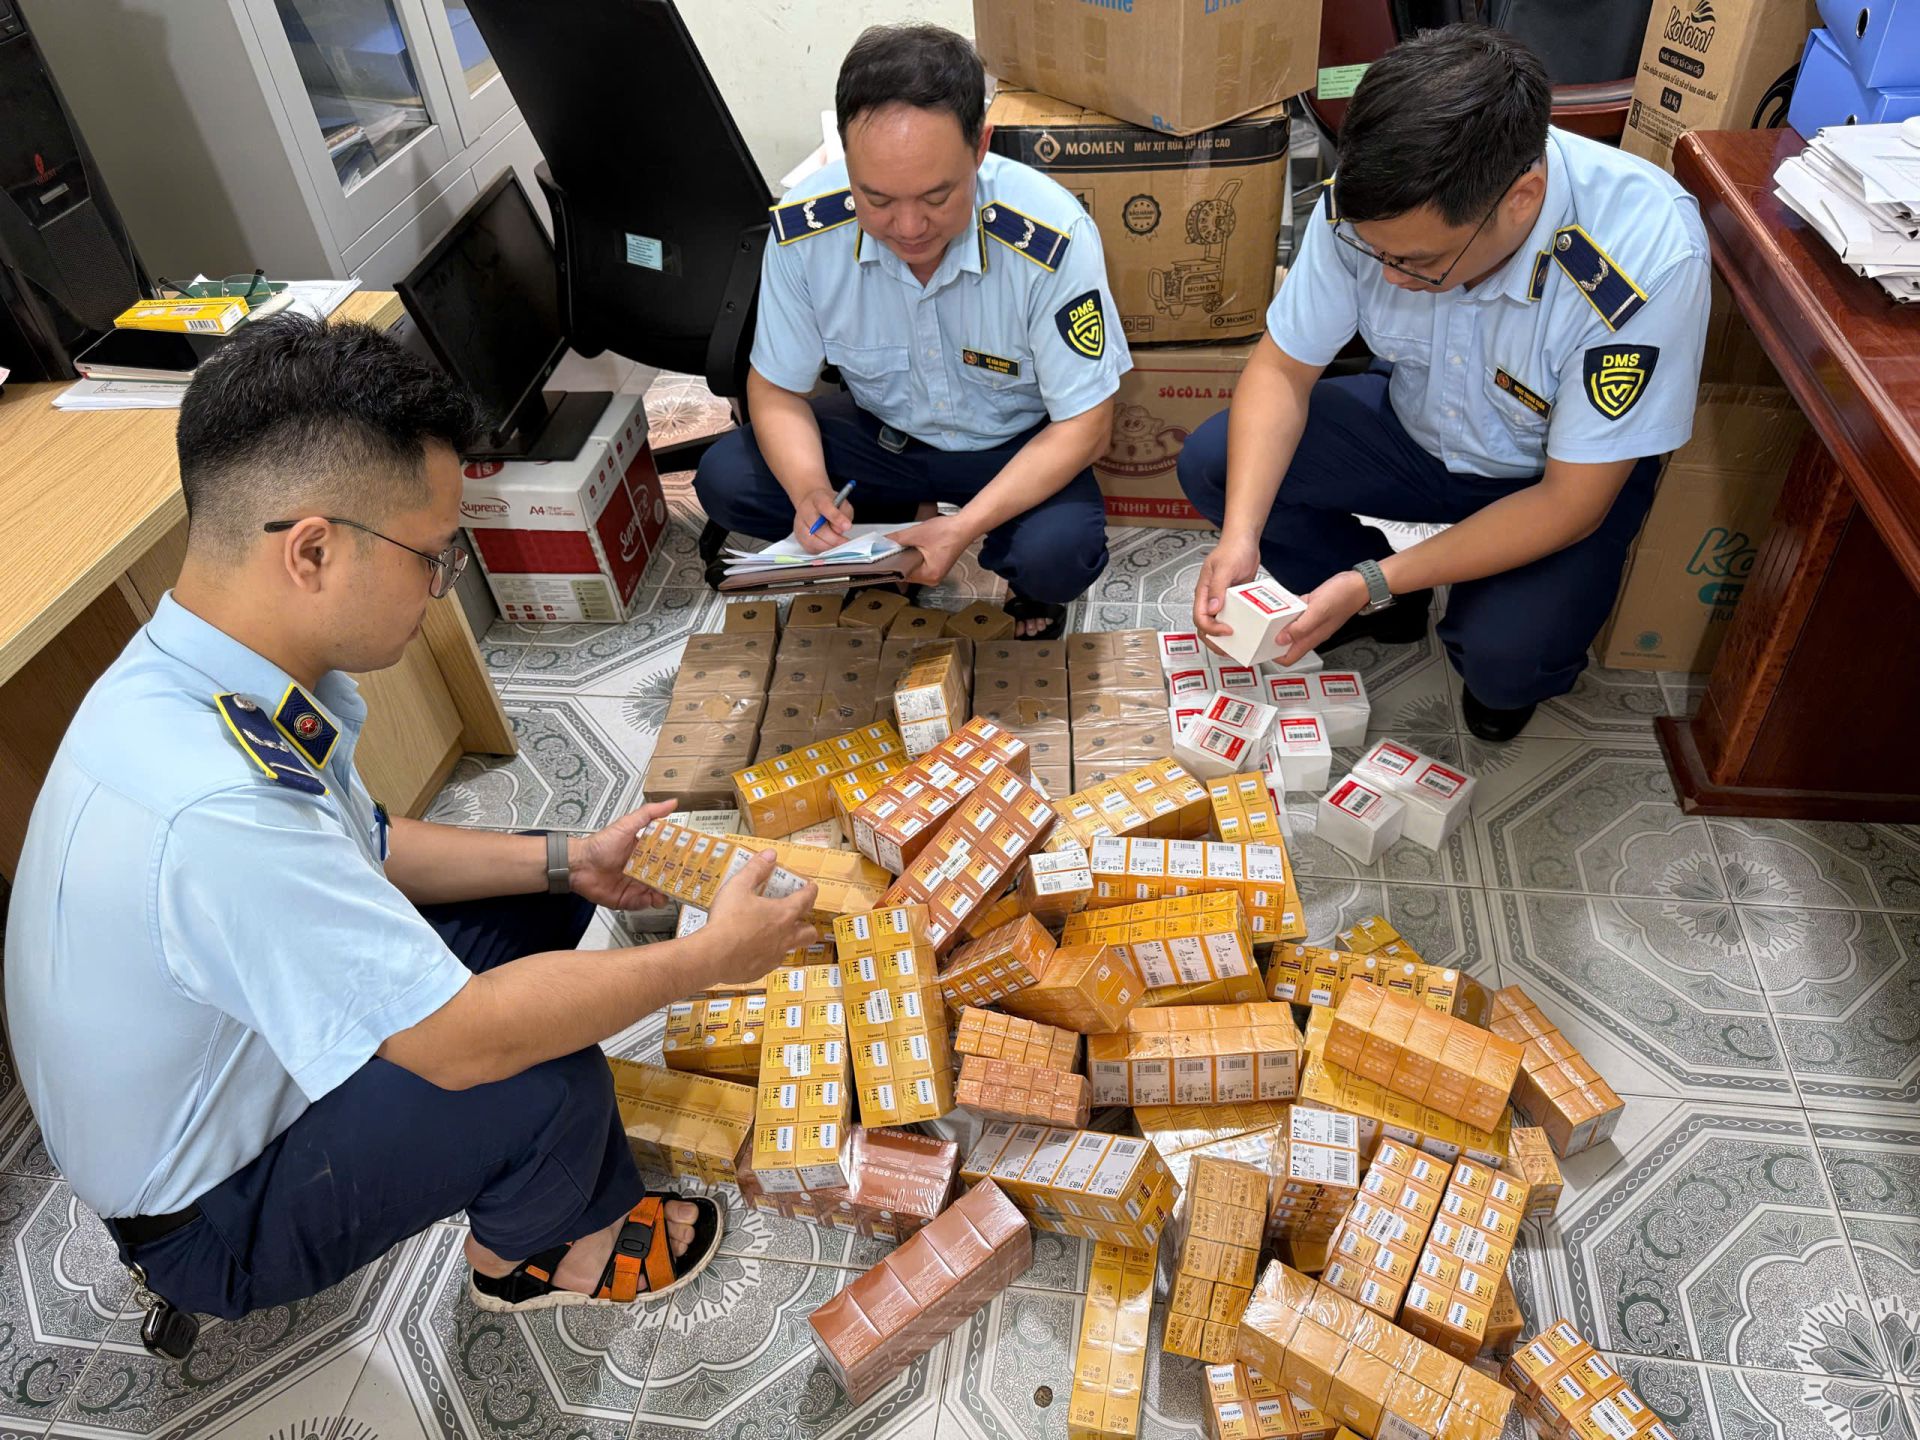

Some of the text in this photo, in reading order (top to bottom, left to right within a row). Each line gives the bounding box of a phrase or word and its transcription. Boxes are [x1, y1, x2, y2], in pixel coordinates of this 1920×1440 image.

[1663, 5, 1715, 54] Kotomi
[1065, 141, 1124, 155] MOMEN
[1215, 138, 1230, 148] CAO
[1187, 284, 1216, 293] MOMEN
[1069, 298, 1095, 322] DMS
[1226, 314, 1253, 323] MOMEN
[1602, 353, 1641, 367] DMS
[462, 501, 507, 514] Supreme
[530, 506, 545, 515] A4
[1110, 502, 1190, 515] TNHH VIỆT
[974, 804, 985, 815] H4
[1029, 800, 1040, 810] H4
[1003, 829, 1013, 840] H4
[738, 848, 750, 860] H4
[924, 863, 933, 875] H4
[977, 860, 987, 871] H4
[775, 869, 786, 879] H4
[950, 890, 961, 901] H4
[885, 913, 892, 925] H4
[847, 920, 853, 932] H4
[890, 955, 897, 966] H4
[852, 961, 859, 972] H4
[782, 973, 788, 983] H4
[822, 969, 828, 979] H4
[1287, 976, 1296, 984] H4
[897, 997, 904, 1008] H4
[1436, 1004, 1446, 1012] H4
[780, 1009, 786, 1019] H4
[820, 1006, 826, 1016] H4
[859, 1003, 865, 1015] H4
[818, 1044, 824, 1055] H4
[864, 1045, 871, 1057] H4
[903, 1040, 910, 1051] H4
[776, 1047, 783, 1058] H4
[773, 1087, 779, 1098] H4
[816, 1085, 822, 1096] H4
[872, 1088, 878, 1100] H4
[910, 1083, 916, 1095] H4
[770, 1129, 776, 1141] H4
[813, 1127, 819, 1138] H4
[1293, 1127, 1301, 1138] H7
[1006, 1171, 1020, 1179] HB3
[1292, 1164, 1300, 1176] H7
[1036, 1176, 1050, 1184] HB3
[1427, 1173, 1433, 1183] H7
[1470, 1175, 1481, 1188] H7
[1069, 1181, 1084, 1189] HB3
[1380, 1185, 1388, 1196] H7
[1103, 1187, 1118, 1196] HB3
[1506, 1191, 1514, 1203] H7
[1415, 1203, 1423, 1212] H7
[1459, 1205, 1468, 1217] H7
[1497, 1221, 1505, 1233] H7
[1403, 1232, 1410, 1243] H7
[1449, 1237, 1457, 1248] H7
[1354, 1246, 1362, 1256] H7
[1487, 1252, 1496, 1264] H7
[1390, 1264, 1399, 1274] H7
[1437, 1268, 1446, 1280] H7
[1340, 1279, 1349, 1289] H7
[1465, 1272, 1475, 1290] PHILIPS
[1476, 1285, 1485, 1297] H7
[1376, 1296, 1385, 1307] H7
[1426, 1300, 1435, 1312] H7
[1453, 1305, 1464, 1324] PHILIPS
[1464, 1318, 1473, 1330] H7
[1561, 1325, 1578, 1344] PHILIPS
[1525, 1350, 1537, 1361] H7
[1533, 1344, 1552, 1364] PHILIPS
[1581, 1362, 1593, 1374] H7
[1590, 1357, 1608, 1378] PHILIPS
[1214, 1383, 1225, 1391] H7
[1252, 1378, 1262, 1386] H7
[1554, 1383, 1566, 1394] H7
[1563, 1378, 1581, 1398] PHILIPS
[1612, 1396, 1625, 1408] H7
[1621, 1391, 1640, 1411] PHILIPS
[1299, 1411, 1310, 1419] H7
[1584, 1417, 1597, 1429] H7
